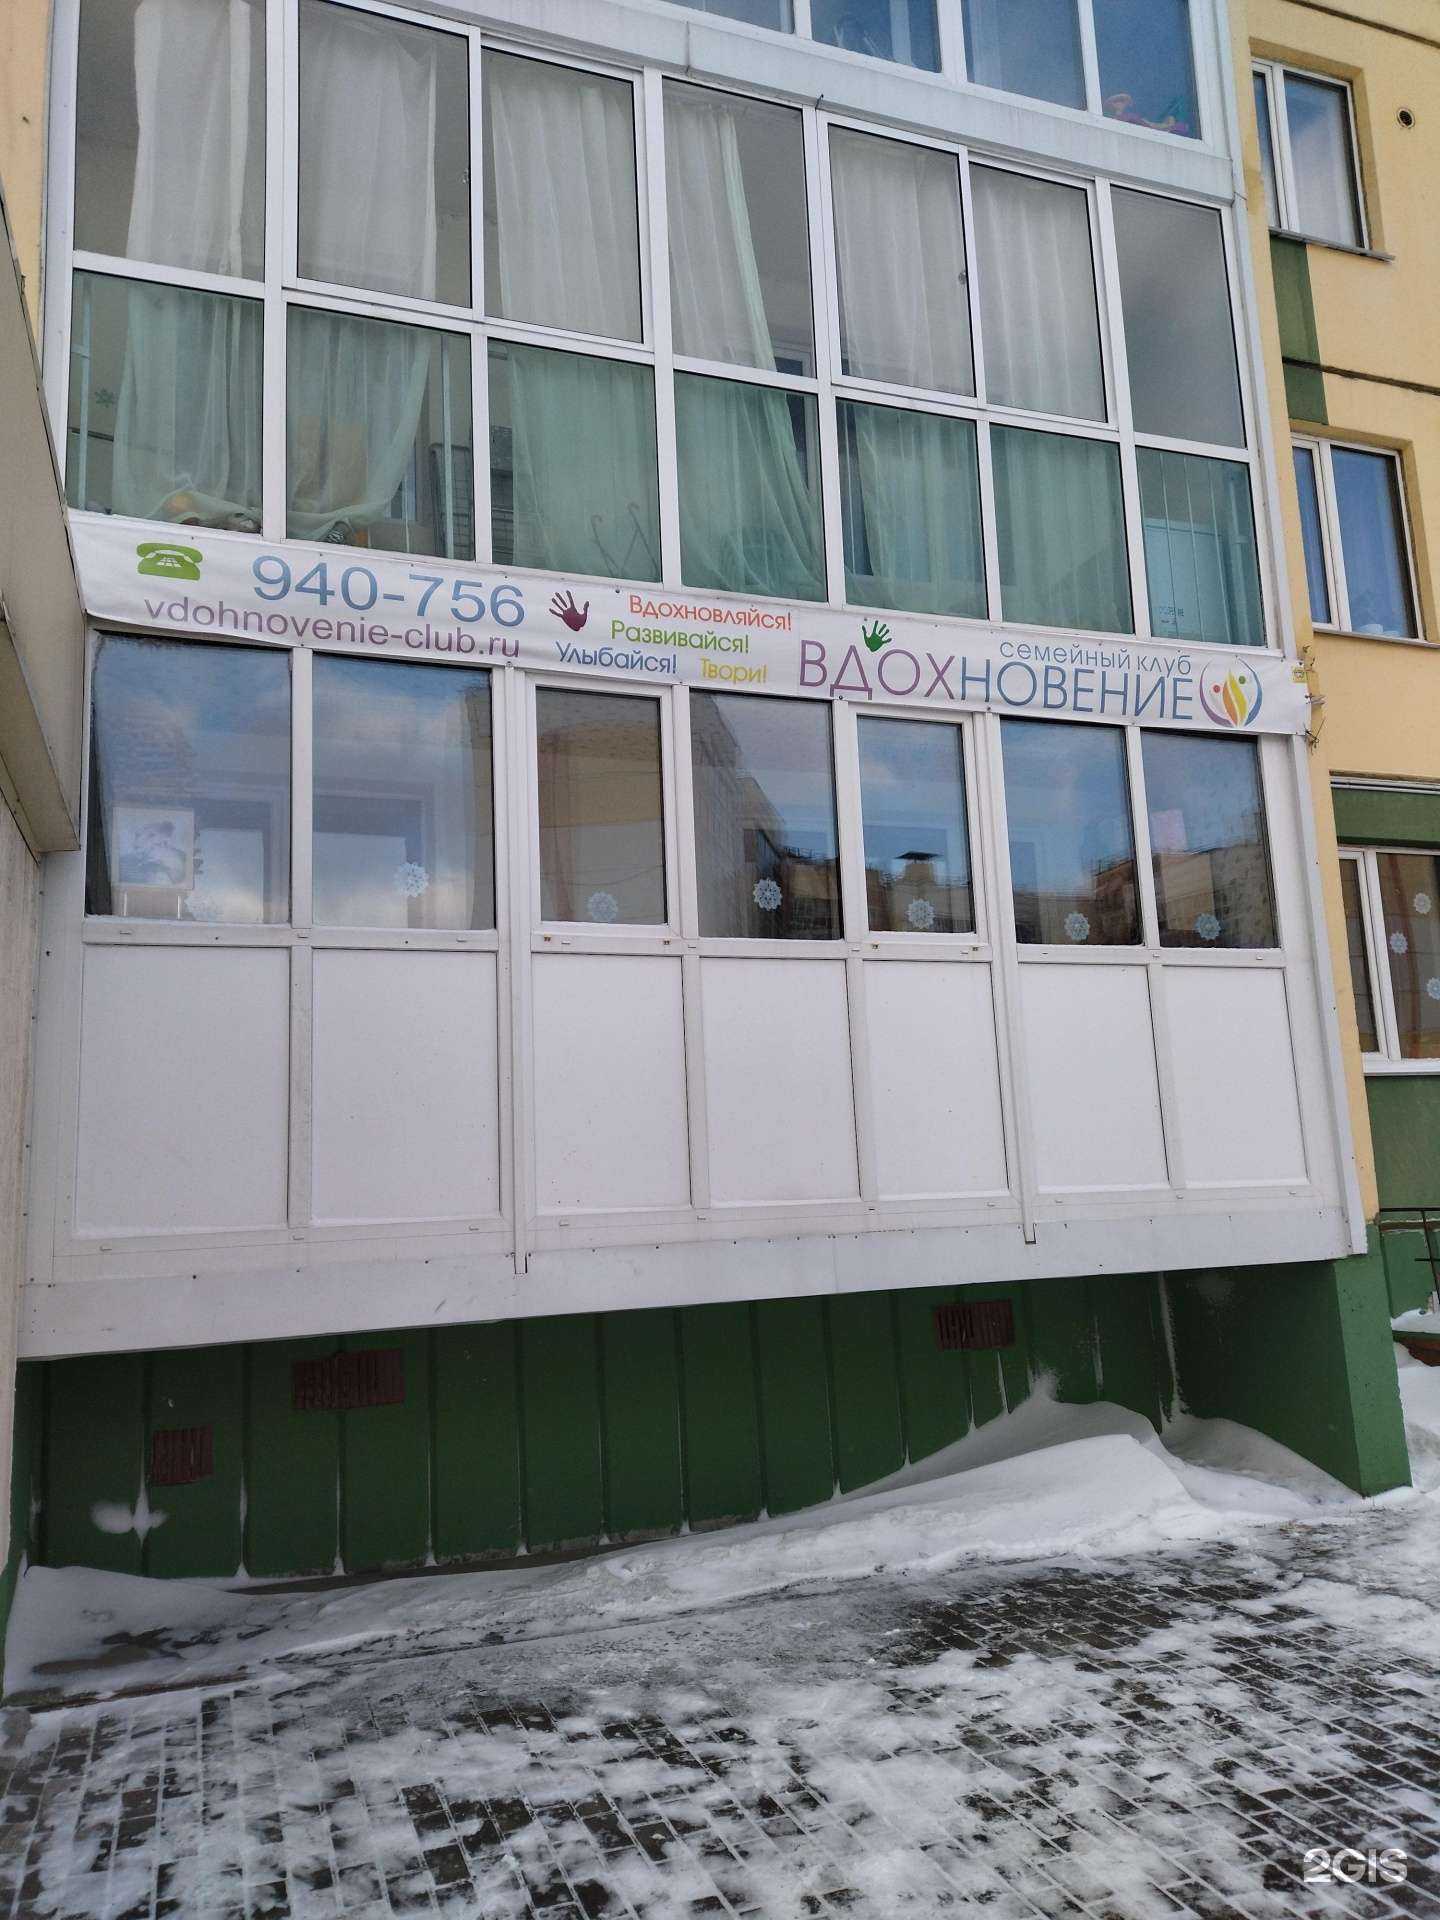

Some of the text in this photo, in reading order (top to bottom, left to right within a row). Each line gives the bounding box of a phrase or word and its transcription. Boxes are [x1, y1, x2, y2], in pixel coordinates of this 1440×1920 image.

[252, 554, 526, 627] 940-756
[145, 596, 521, 658] vdohnovenie-club.ru
[630, 594, 792, 631] Вдохновляйся!
[611, 619, 749, 653] Развивайся!
[555, 641, 767, 684] Улыбайся! Твори!
[799, 639, 1193, 720] ВДОХНОВЕНИЕ
[1000, 641, 1192, 679] семейный клуб
